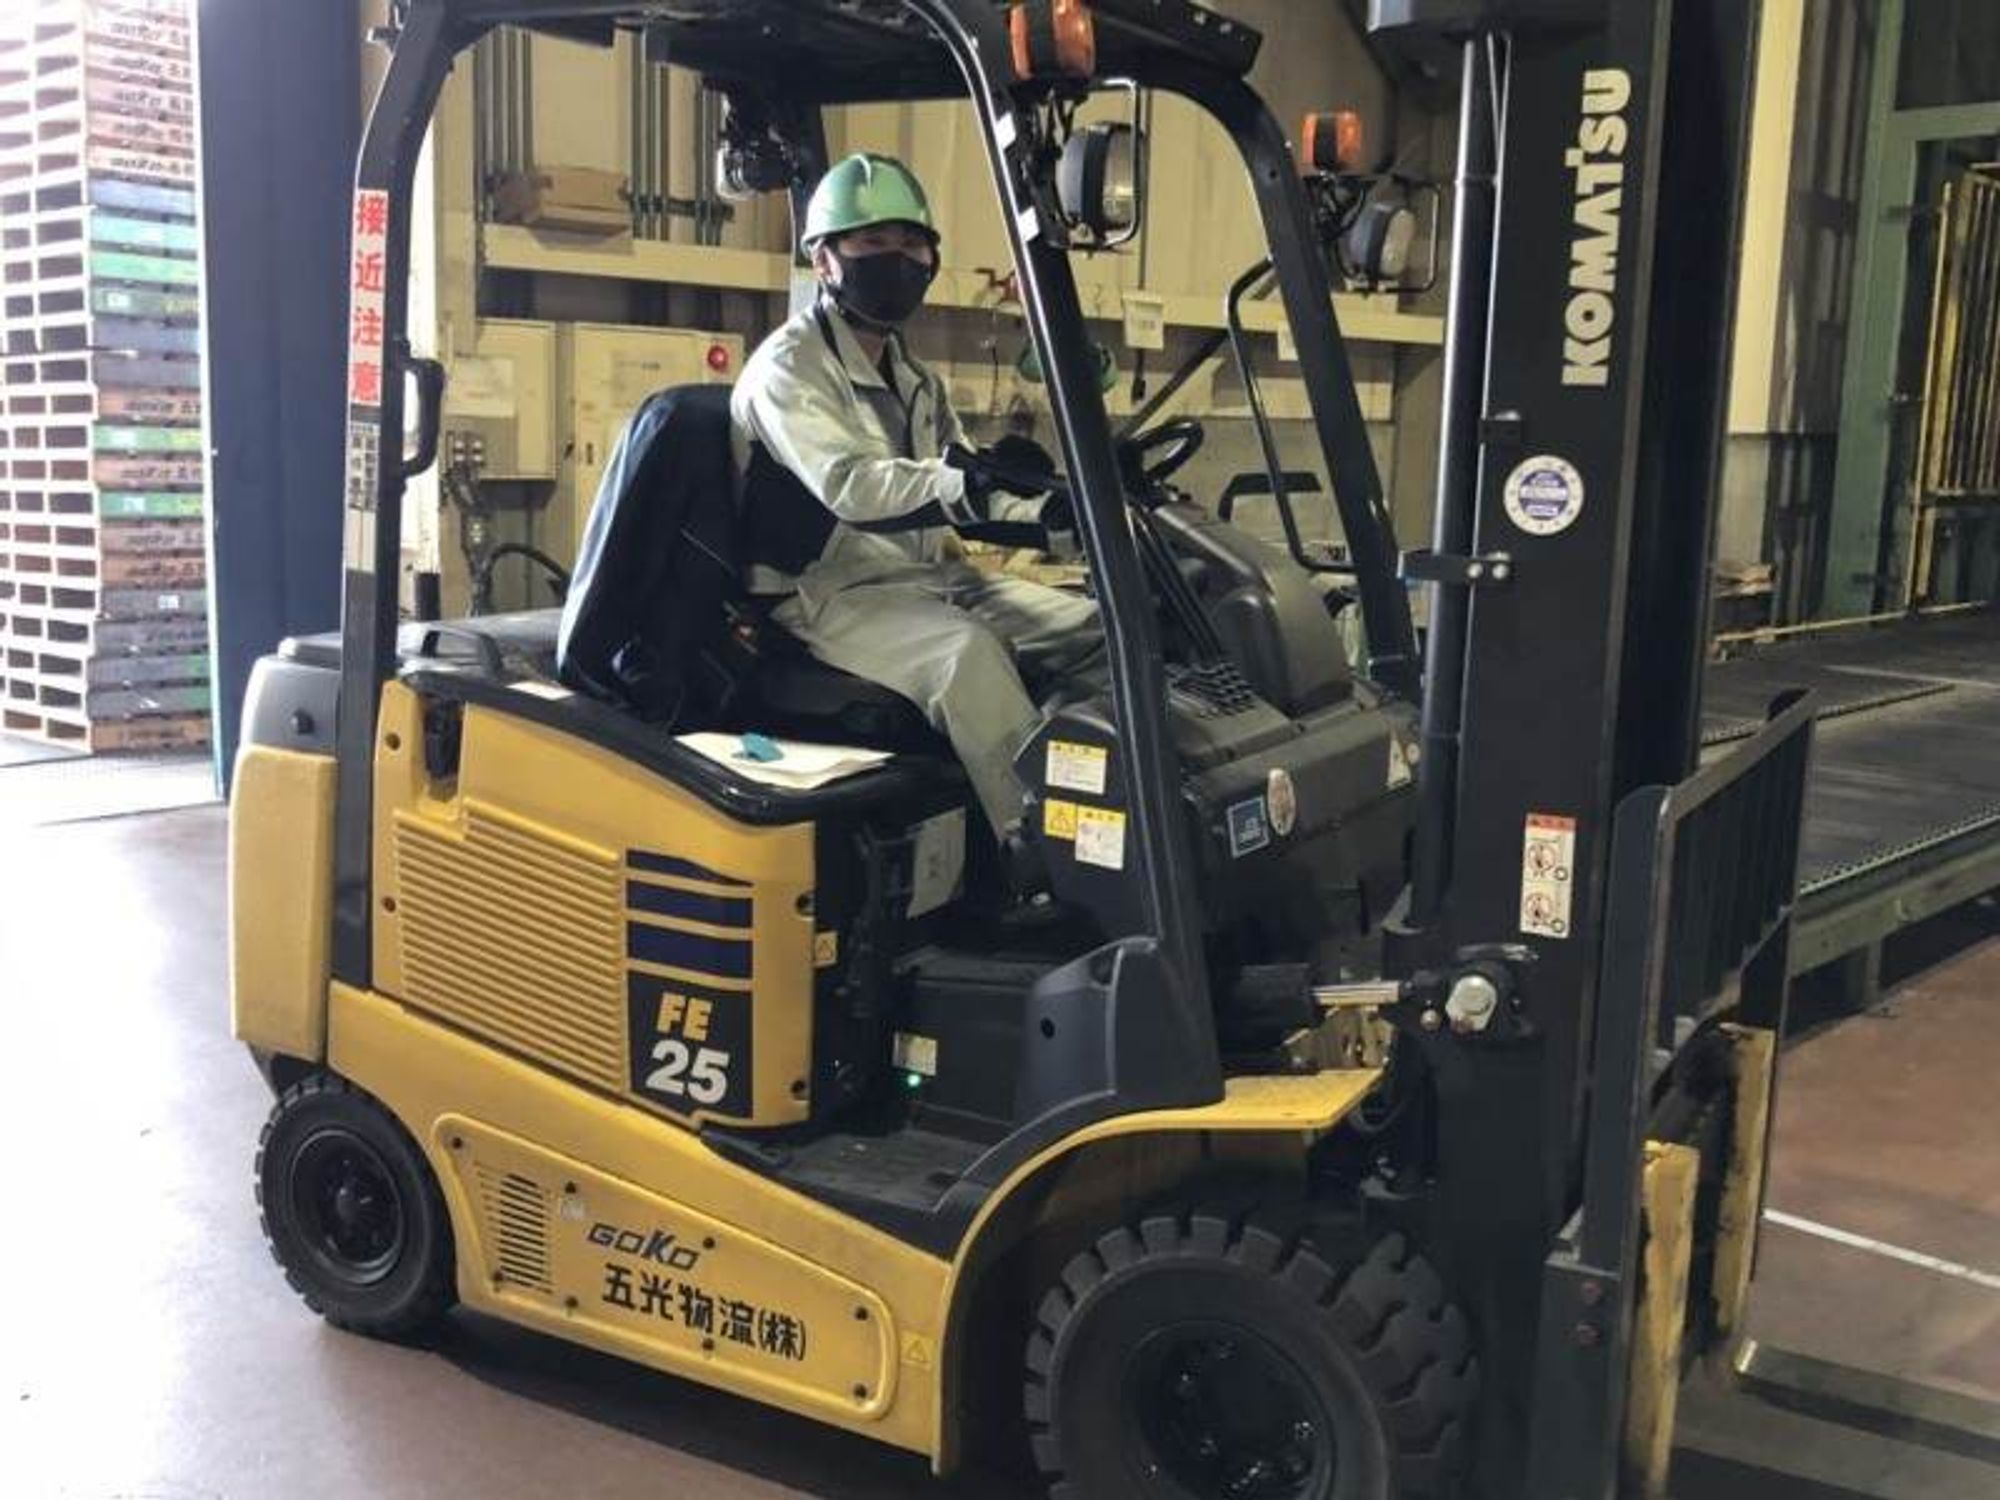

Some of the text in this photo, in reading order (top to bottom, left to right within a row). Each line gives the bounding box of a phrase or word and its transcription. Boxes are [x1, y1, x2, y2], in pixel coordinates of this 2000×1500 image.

[1561, 68, 1632, 387] KOMATSU
[352, 193, 386, 402] 接近注意
[656, 991, 714, 1041] FE
[645, 1039, 730, 1104] 25
[602, 1262, 807, 1361] 五光物流(株)
